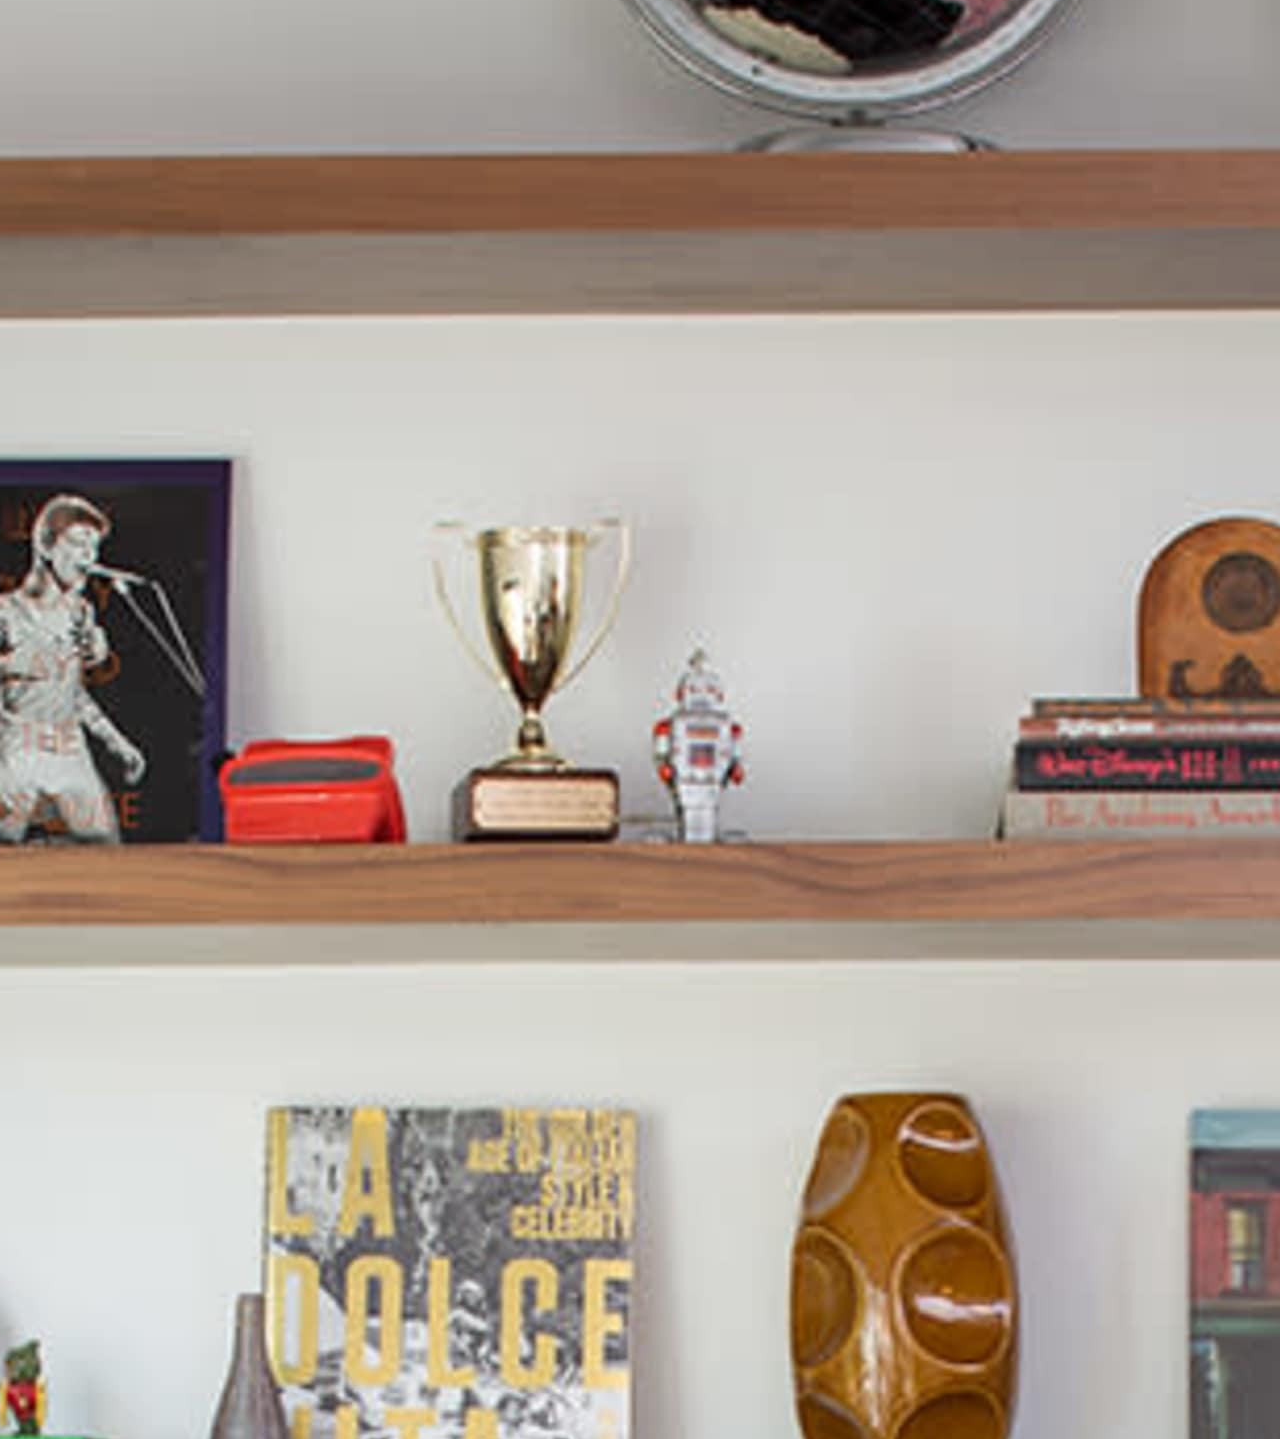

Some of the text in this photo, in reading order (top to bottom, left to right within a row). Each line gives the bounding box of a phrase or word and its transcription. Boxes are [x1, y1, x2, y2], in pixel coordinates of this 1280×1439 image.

[17, 720, 82, 756] THE
[268, 1108, 396, 1238] LA
[268, 1253, 633, 1389] DOLCE
